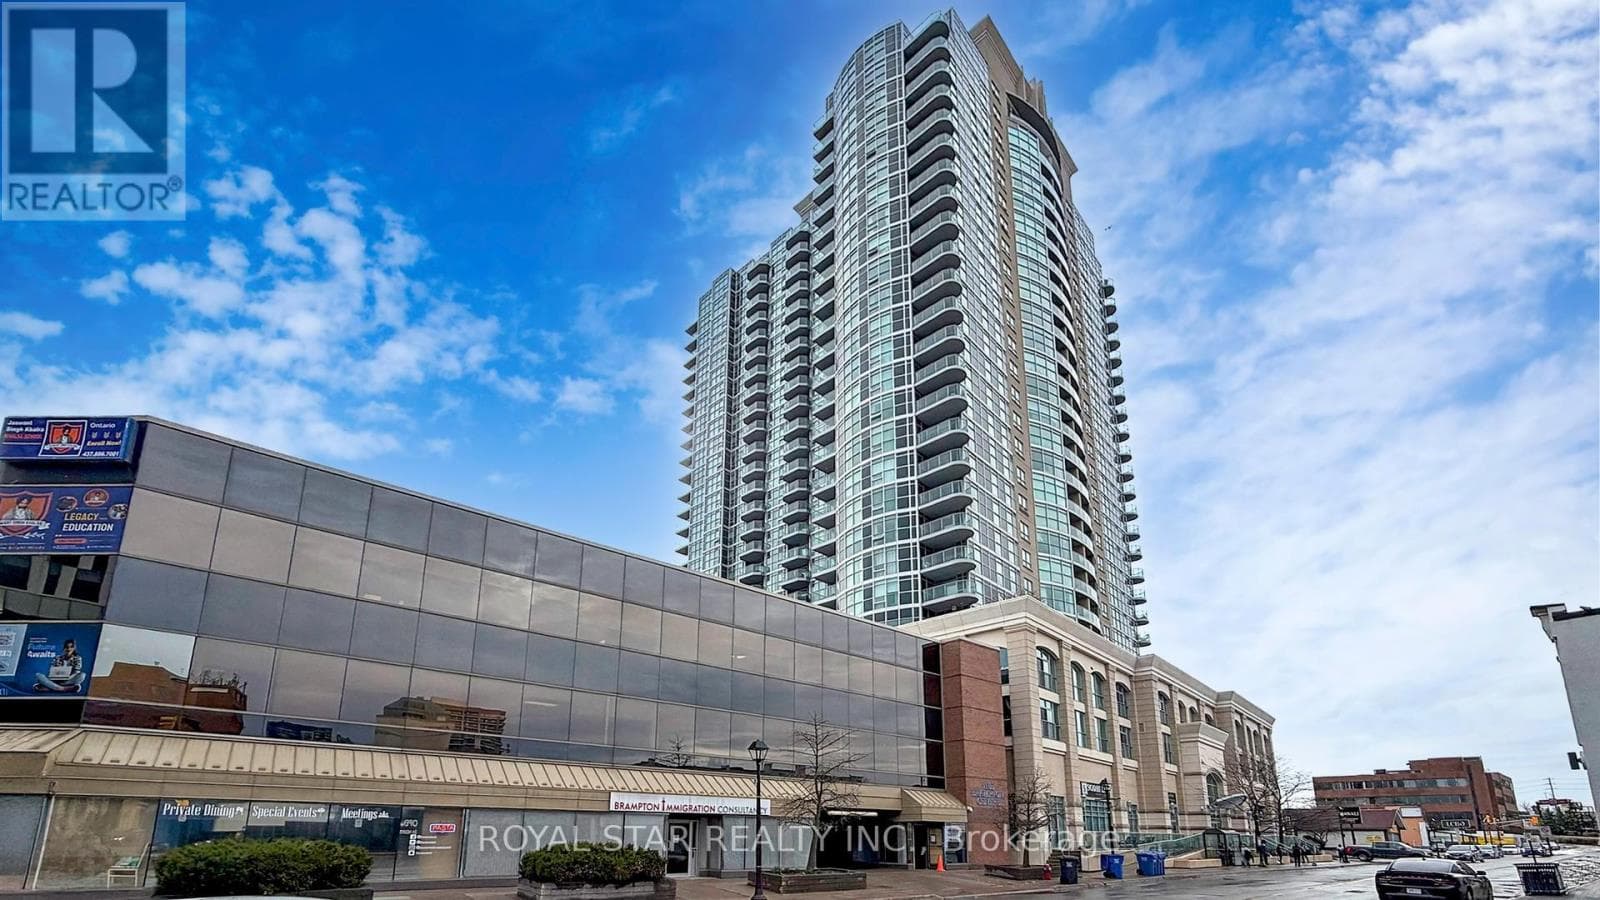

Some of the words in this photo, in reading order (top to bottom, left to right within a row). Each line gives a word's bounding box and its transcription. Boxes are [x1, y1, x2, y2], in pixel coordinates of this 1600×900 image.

[64, 512, 100, 521] LEGACY
[62, 523, 114, 532] EDUCATION
[162, 803, 202, 816] Private
[203, 804, 236, 819] Dining
[614, 801, 660, 811] BRAMPTON
[662, 797, 715, 813] IMMIGRATION
[251, 805, 286, 819] Special
[287, 807, 318, 818] Events
[341, 808, 379, 820] Meetings
